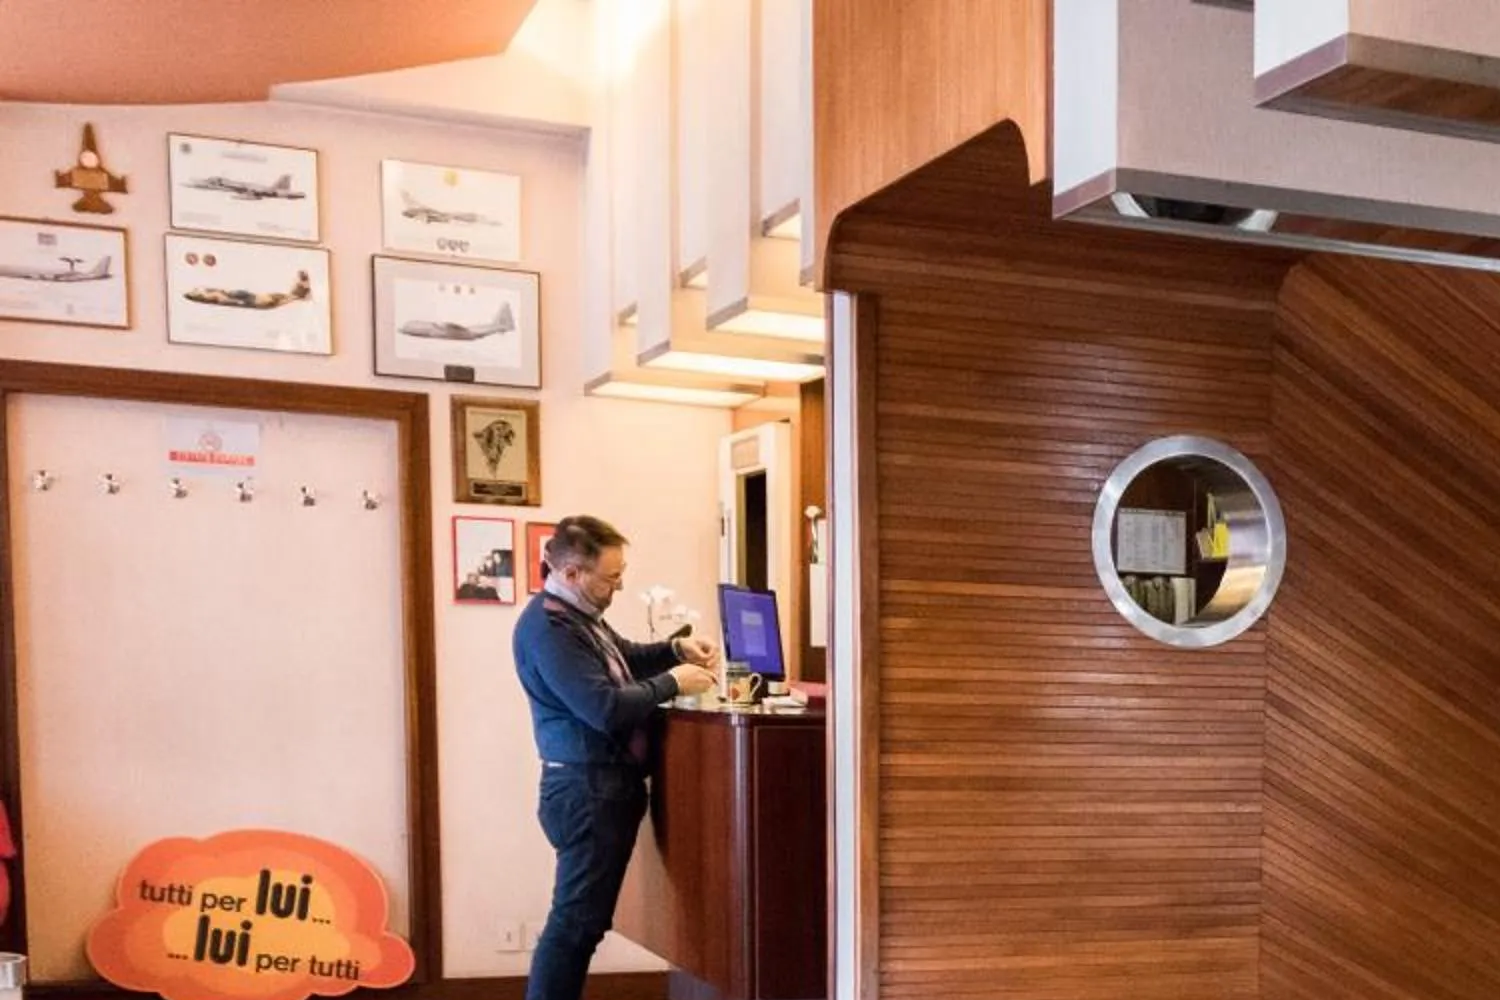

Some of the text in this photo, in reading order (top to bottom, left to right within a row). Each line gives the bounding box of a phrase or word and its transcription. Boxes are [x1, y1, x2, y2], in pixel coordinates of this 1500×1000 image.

[139, 880, 193, 905] tutti
[200, 892, 246, 912] per
[256, 951, 301, 973] per
[308, 955, 360, 980] tutti
